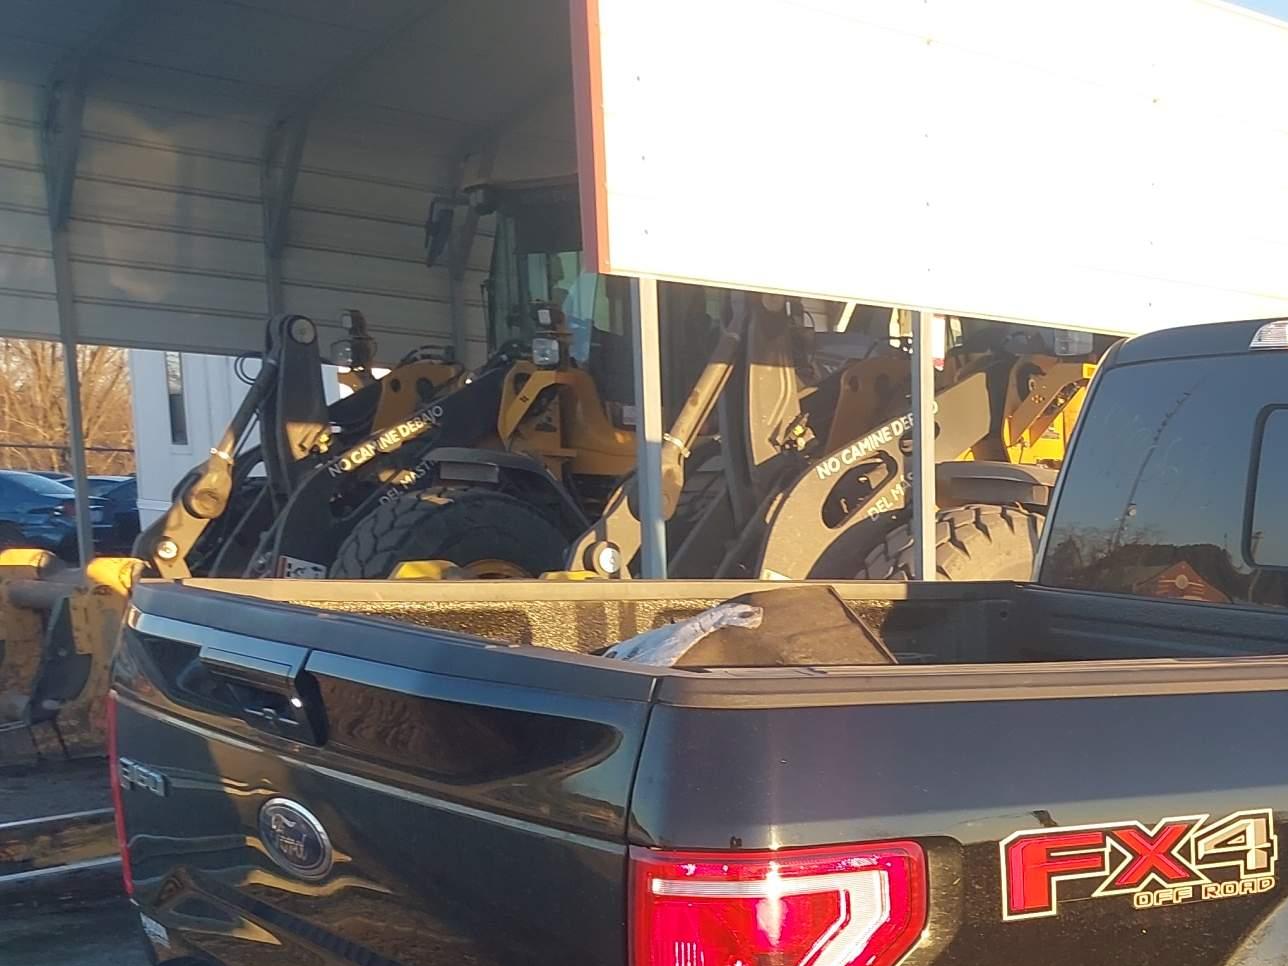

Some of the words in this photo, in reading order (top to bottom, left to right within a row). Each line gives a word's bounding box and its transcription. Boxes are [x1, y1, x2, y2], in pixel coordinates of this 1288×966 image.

[328, 457, 352, 478] NO
[399, 405, 444, 437] DEBAJO
[816, 457, 841, 480] NO
[841, 424, 893, 466] CAMINE
[867, 496, 894, 521] DEL
[998, 807, 1279, 921] FX4
[1133, 886, 1193, 909] OFF
[1201, 876, 1276, 900] ROAD
